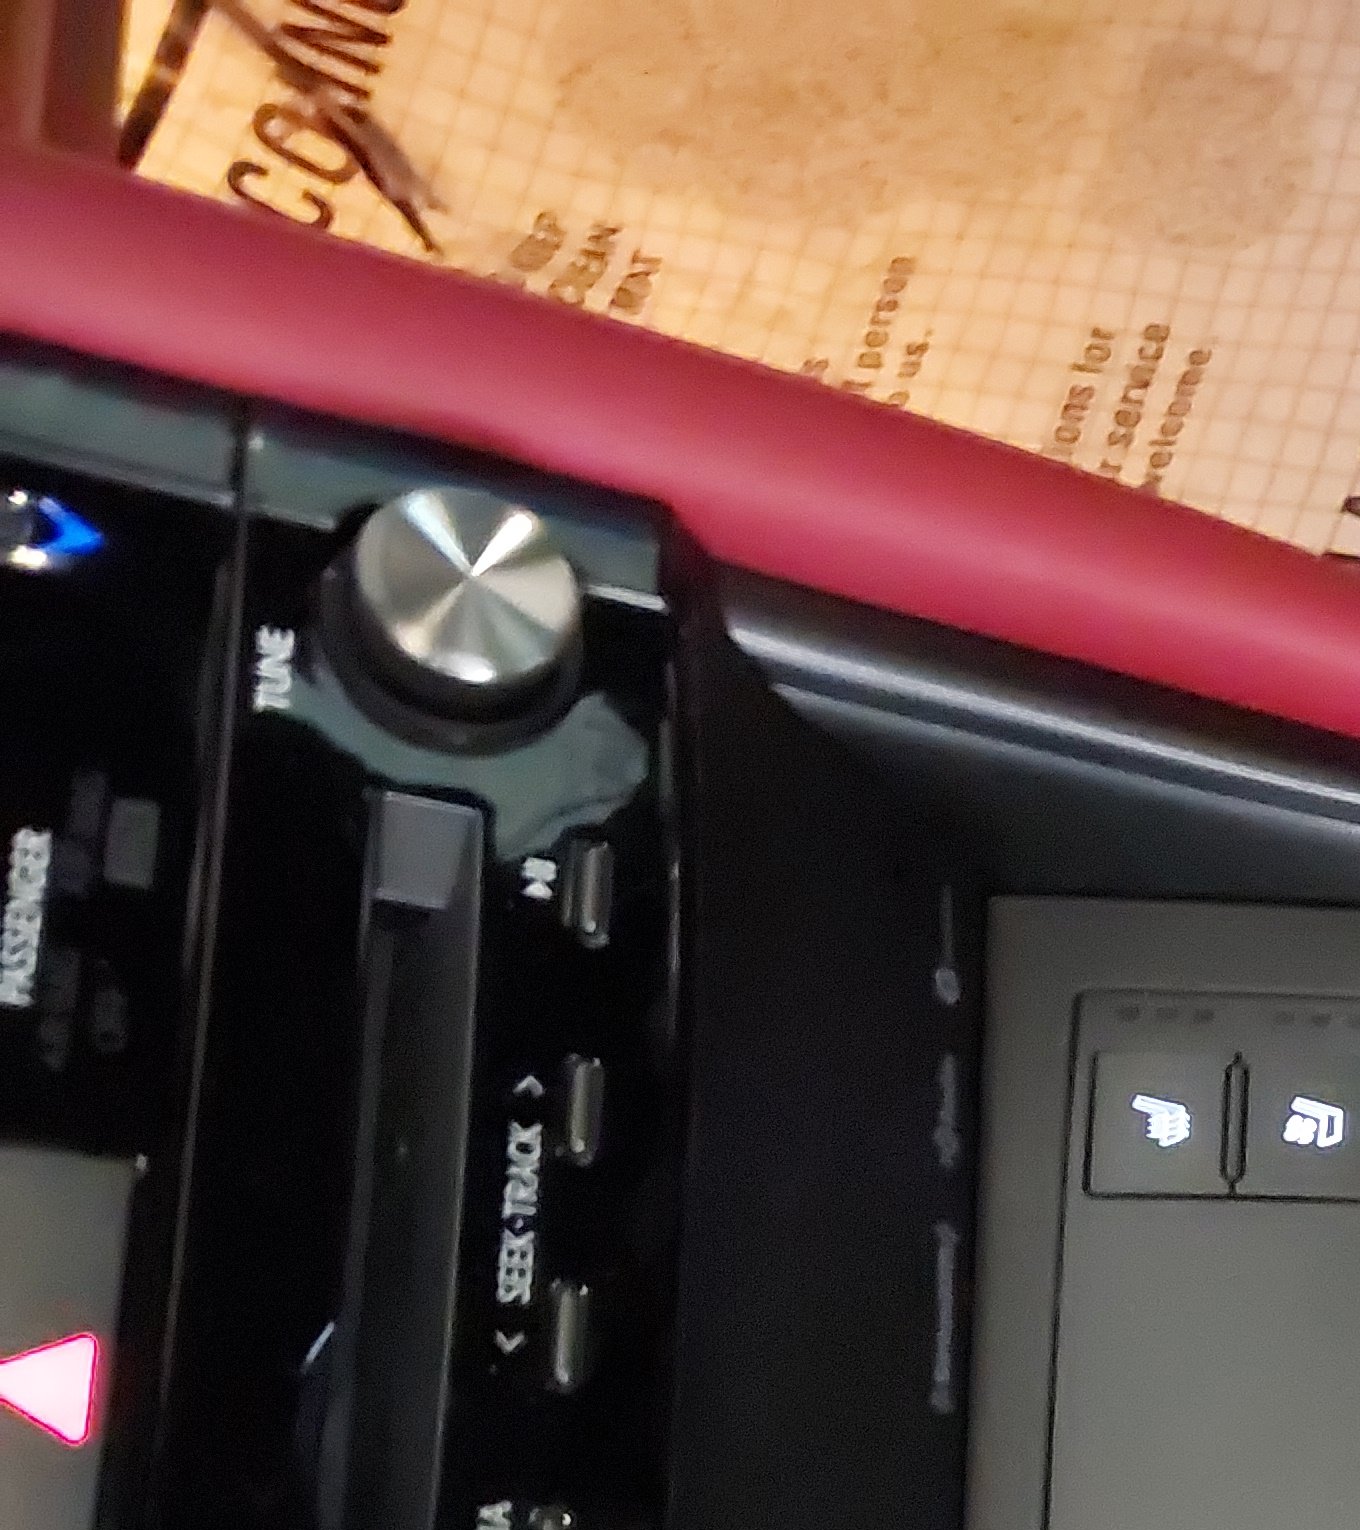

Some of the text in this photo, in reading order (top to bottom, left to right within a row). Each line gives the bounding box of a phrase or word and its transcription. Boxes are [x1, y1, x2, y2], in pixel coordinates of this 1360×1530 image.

[857, 256, 917, 370] person
[1069, 327, 1114, 374] for
[1106, 323, 1170, 448] service
[255, 627, 295, 711] TUNE
